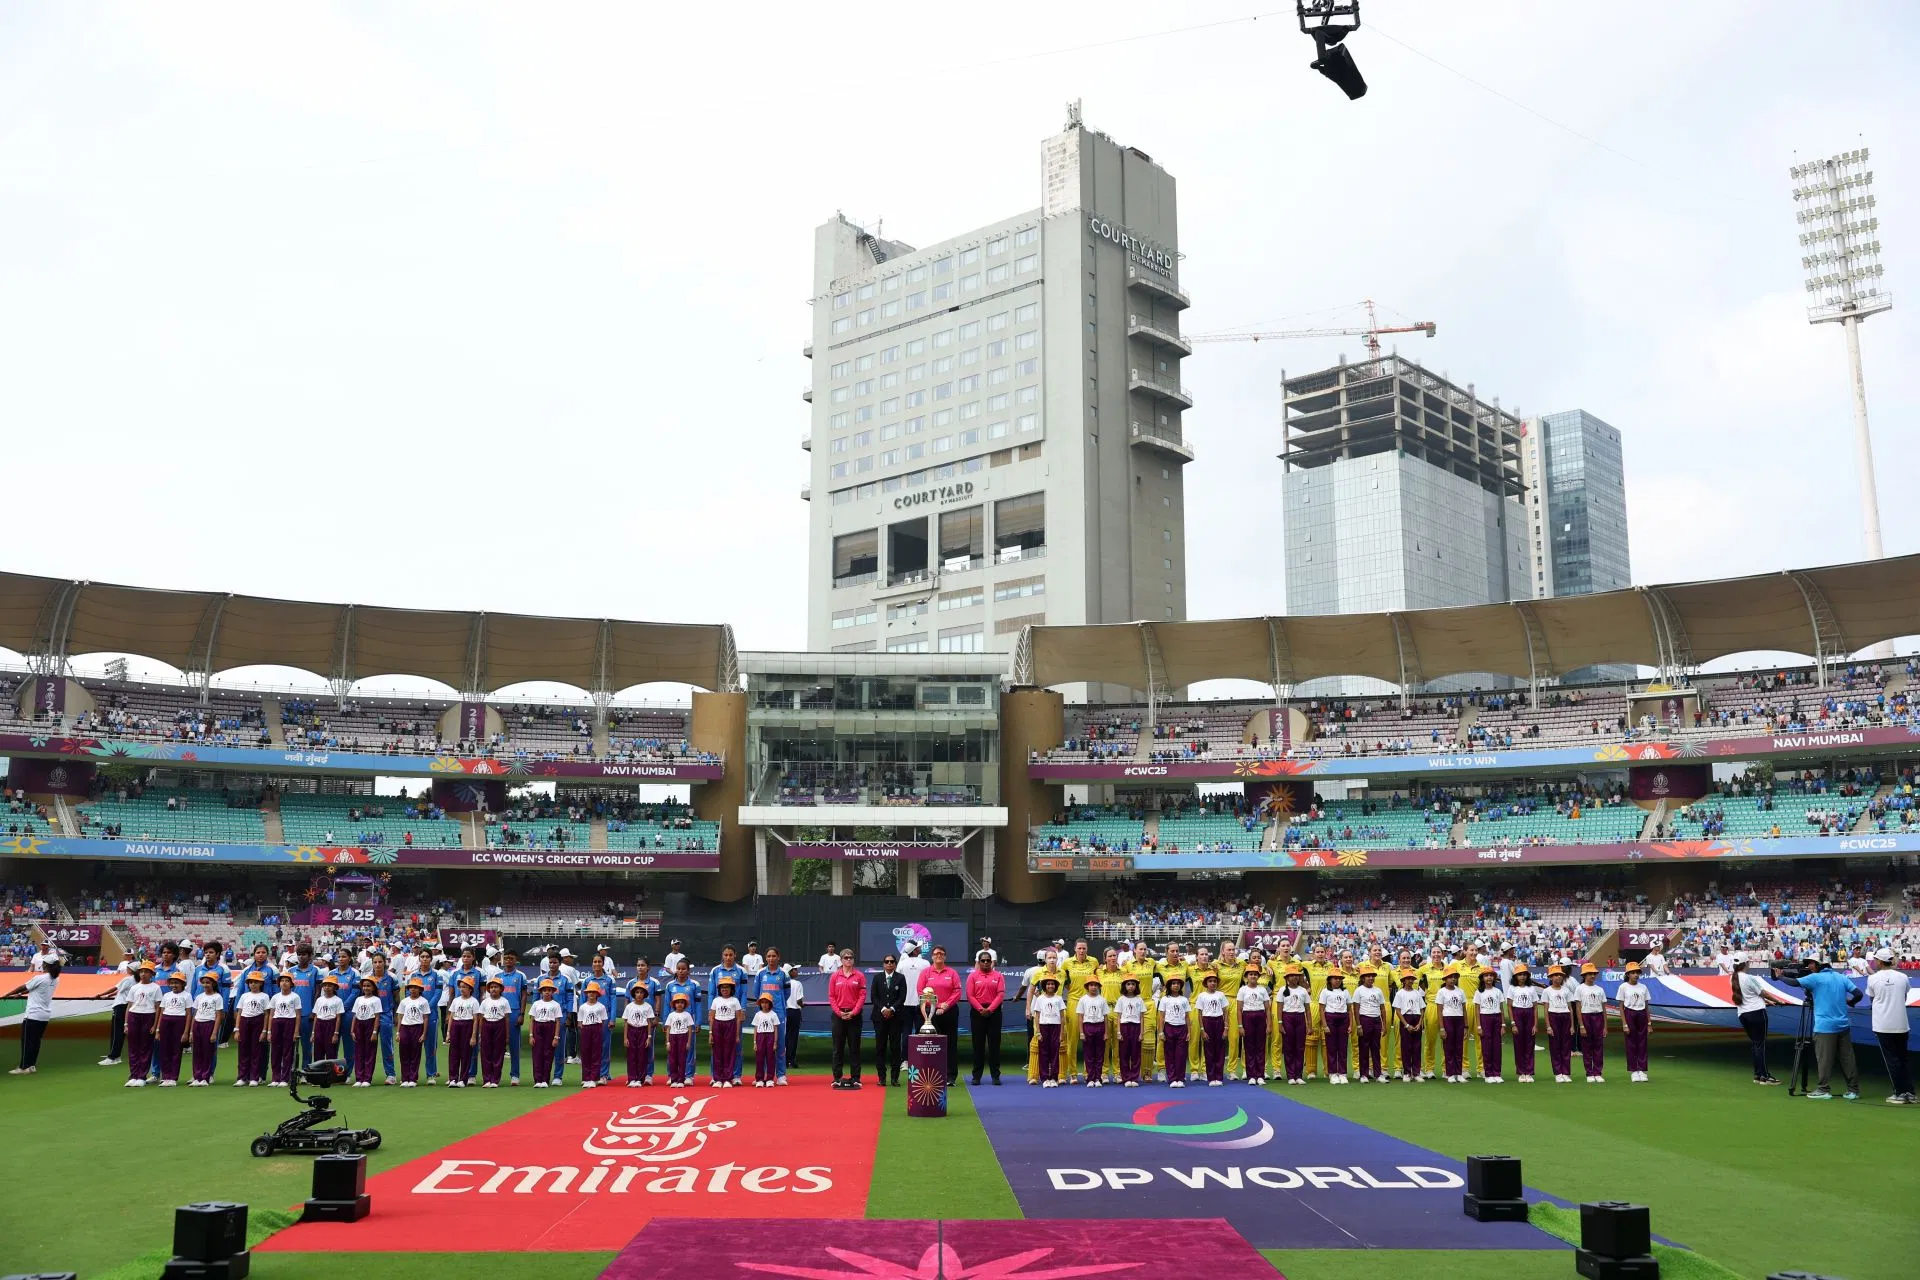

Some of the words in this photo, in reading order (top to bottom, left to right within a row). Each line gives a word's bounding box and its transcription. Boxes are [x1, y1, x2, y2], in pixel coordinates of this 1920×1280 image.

[1091, 218, 1173, 269] COURTYARD
[1131, 253, 1140, 263] BY
[1141, 258, 1172, 279] MARRIOTT
[894, 481, 974, 509] COURTYARD
[1773, 737, 1806, 748] NAVI
[1808, 732, 1864, 746] MUMBAI
[284, 752, 303, 762] नवी
[1428, 758, 1454, 768] WILL
[1456, 757, 1472, 767] TO
[1474, 756, 1497, 765] WIN
[603, 766, 630, 775] NAVI
[631, 766, 676, 776] MUMBAI
[1124, 767, 1168, 776] #CWC25
[125, 844, 158, 855] NAVI
[160, 846, 215, 857] MUMBAI
[1840, 839, 1897, 851] #CWC25
[472, 853, 491, 862] ICC
[493, 854, 544, 863] WOMEN'S
[546, 855, 591, 864] CRICKET
[593, 856, 632, 865] WORLD
[633, 856, 655, 865] CUP
[1478, 849, 1497, 859] नवी
[1055, 860, 1069, 868] IND
[1093, 860, 1109, 868] AUS
[410, 1158, 833, 1194] Emirates
[1046, 1168, 1154, 1190] DP
[1161, 1166, 1466, 1190] WORLD
